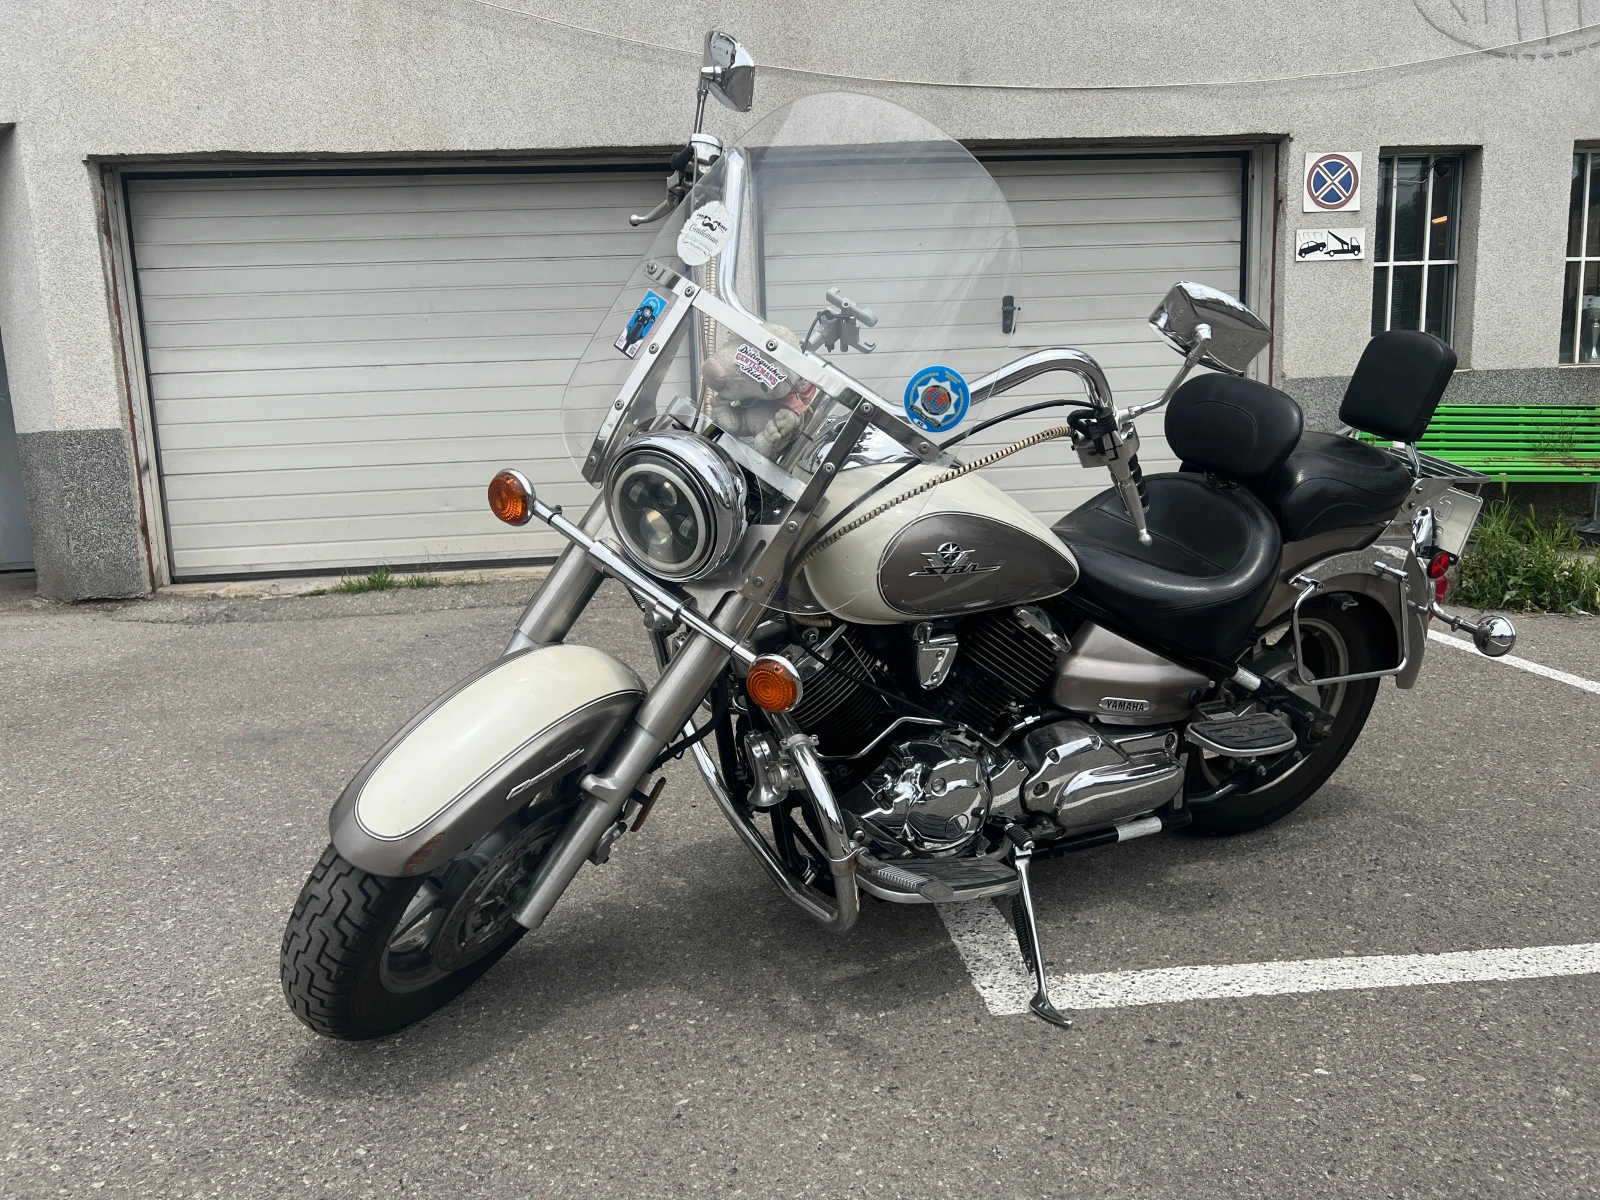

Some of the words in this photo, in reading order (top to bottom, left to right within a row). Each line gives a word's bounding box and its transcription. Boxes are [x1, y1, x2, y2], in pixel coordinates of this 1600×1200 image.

[688, 223, 719, 245] Gentleman
[735, 352, 778, 386] GENTLEMANS
[738, 345, 787, 381] Distinguished
[741, 366, 763, 381] Ride
[1106, 700, 1144, 712] YAMAHA
